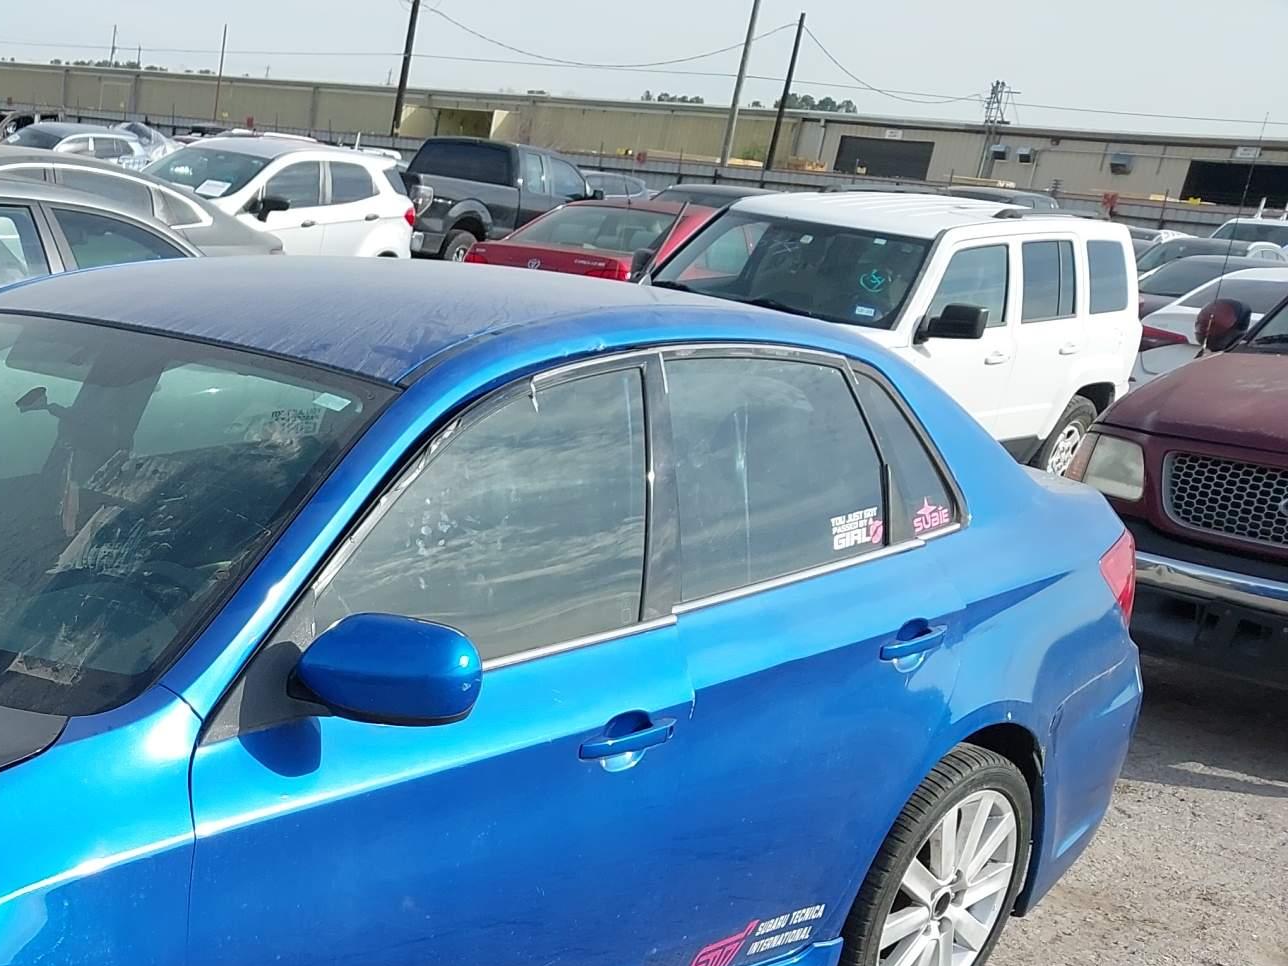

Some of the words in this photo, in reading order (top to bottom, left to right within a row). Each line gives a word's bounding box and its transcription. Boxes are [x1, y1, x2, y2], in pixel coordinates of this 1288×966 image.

[830, 515, 847, 527] YOU
[847, 511, 864, 523] JUST
[863, 506, 878, 519] GOT
[832, 521, 859, 535] PASSED
[858, 519, 868, 528] BY
[833, 526, 872, 551] GIRL
[755, 913, 791, 937] SUBARU
[788, 903, 826, 926] TECNICA
[747, 925, 813, 956] INTERNATIONAL
